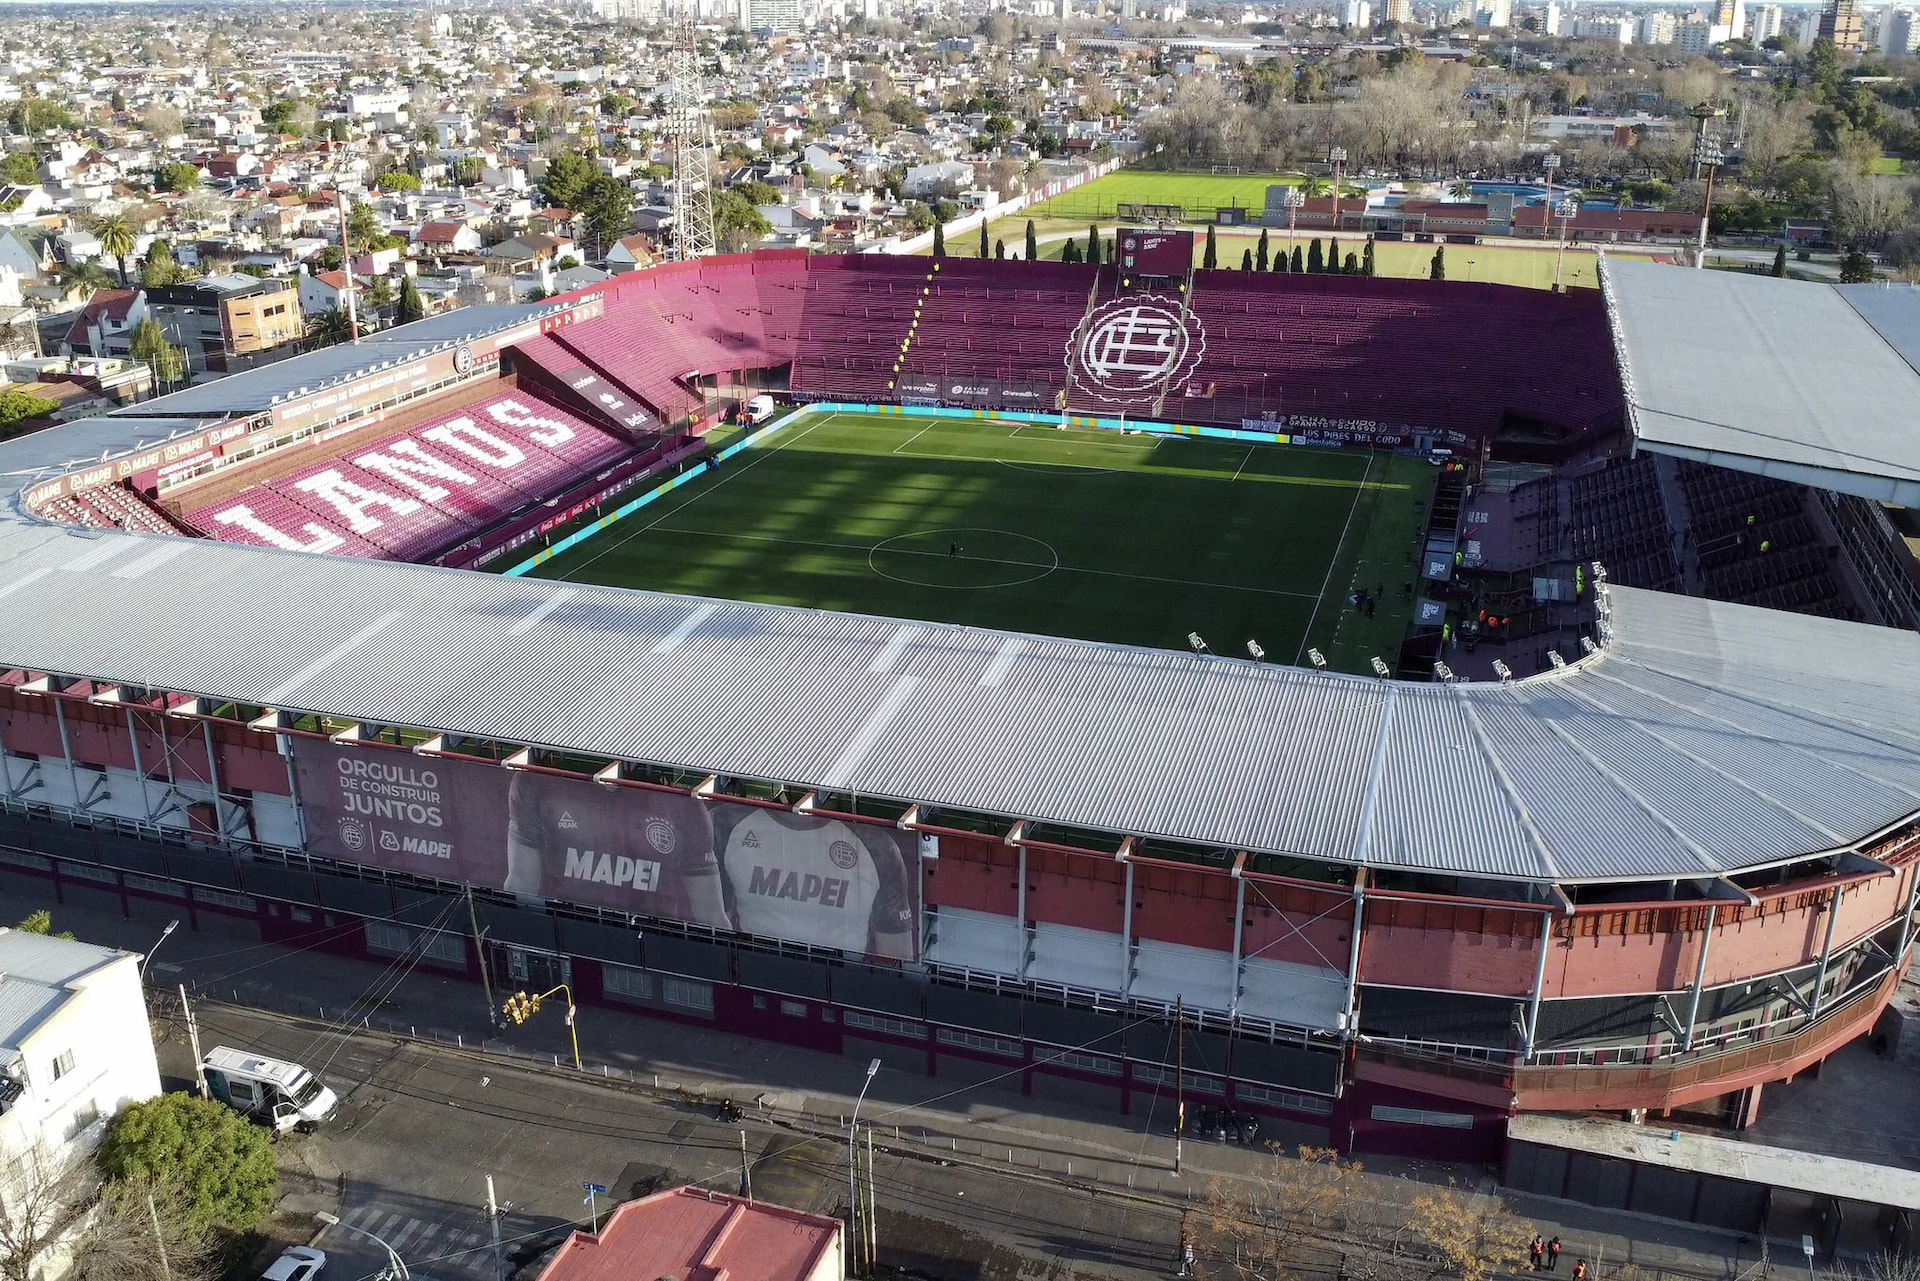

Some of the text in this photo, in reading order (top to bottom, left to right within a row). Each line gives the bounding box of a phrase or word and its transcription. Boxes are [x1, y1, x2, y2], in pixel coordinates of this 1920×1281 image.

[221, 423, 245, 440] MAPEI
[1303, 429, 1401, 444] LOS PIBES DEL CODO
[178, 438, 204, 455] MAPEI
[132, 452, 161, 470] MAPEI
[84, 467, 113, 487] MAPEI
[37, 482, 62, 502] MAPEI
[337, 757, 439, 790] ORGULLO
[339, 776, 442, 805] DE CONSTRUIR
[343, 792, 443, 829] JUNTOS
[557, 819, 578, 830] PEAK
[402, 835, 453, 860] MAPEI
[741, 840, 762, 849] PEAK
[563, 850, 661, 893] MAPEI
[748, 865, 850, 909] MAPEI
